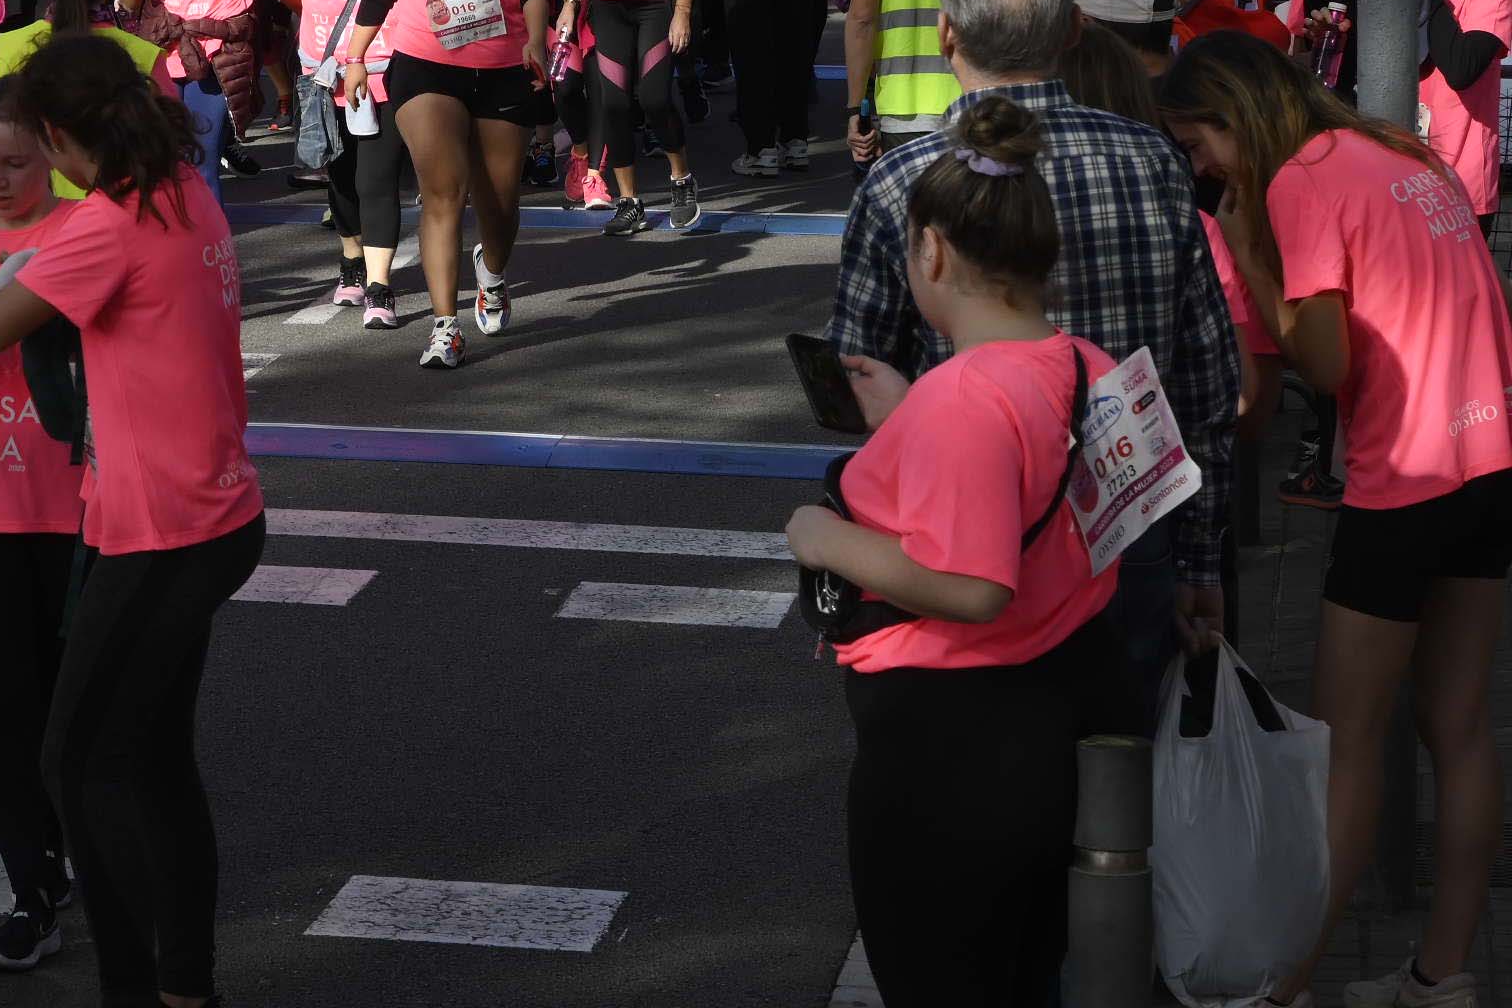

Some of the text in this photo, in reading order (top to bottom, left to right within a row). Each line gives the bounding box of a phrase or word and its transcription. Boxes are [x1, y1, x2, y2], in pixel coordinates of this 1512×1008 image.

[452, 1, 476, 16] 016
[1416, 191, 1444, 217] DE
[1426, 205, 1477, 241] MUJER
[1448, 405, 1499, 438] OYSHO
[1094, 435, 1135, 480] 016
[1106, 464, 1138, 498] 27213
[1148, 472, 1189, 509] Santander
[1098, 524, 1126, 559] OYSHO
